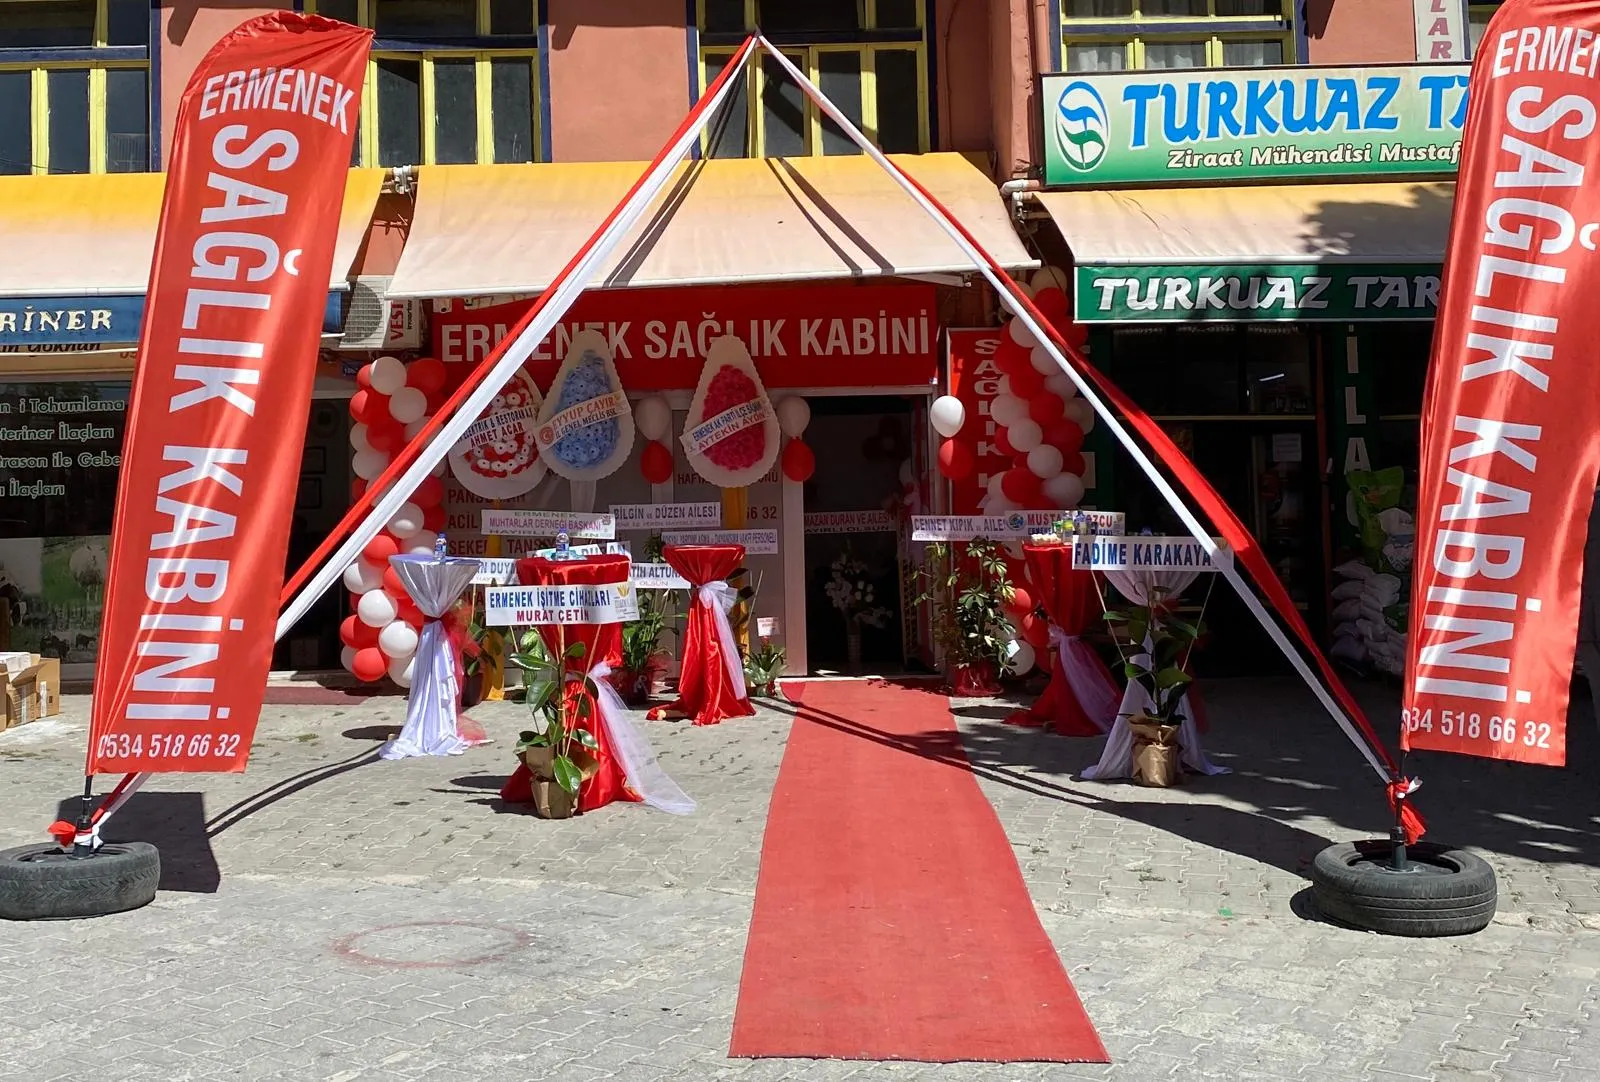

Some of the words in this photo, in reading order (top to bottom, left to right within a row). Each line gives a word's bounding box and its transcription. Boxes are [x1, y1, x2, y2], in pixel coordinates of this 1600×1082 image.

[199, 67, 354, 135] ERMENEK
[1123, 76, 1401, 150] TURKUAZ
[1167, 149, 1244, 169] Ziraat
[1250, 143, 1372, 166] Mühendisi
[1379, 140, 1461, 163] Mustaf
[169, 124, 302, 417] SAĞLIK
[1092, 275, 1330, 312] TURKUAZ
[1348, 275, 1441, 310] TAR
[441, 322, 633, 363] ERENK
[800, 309, 929, 355] KABİNİ
[29, 396, 124, 413] Tohumlama
[59, 421, 114, 442] İlaçları
[470, 429, 498, 449] AHMET
[501, 422, 524, 437] ACAR
[52, 452, 72, 467] ile
[9, 478, 65, 499] İlaçları
[614, 508, 644, 520] BİLGİN
[655, 506, 685, 519] DÜZEN
[762, 506, 777, 519] 32
[1074, 538, 1126, 565] FADİME
[1134, 544, 1211, 566] KARAKAYA
[1415, 415, 1542, 703] KABİNİ
[125, 445, 248, 720] KABİNİ
[490, 591, 533, 608] ERMENEK
[537, 587, 565, 610] İŞİTME
[516, 610, 553, 622] MURAT
[558, 609, 589, 623] ÇETİN
[1441, 709, 1480, 739] 518
[1489, 715, 1516, 744] 66
[1523, 720, 1551, 748] 32
[149, 733, 184, 758] 518
[187, 734, 211, 757] 66
[214, 734, 240, 757] 32
